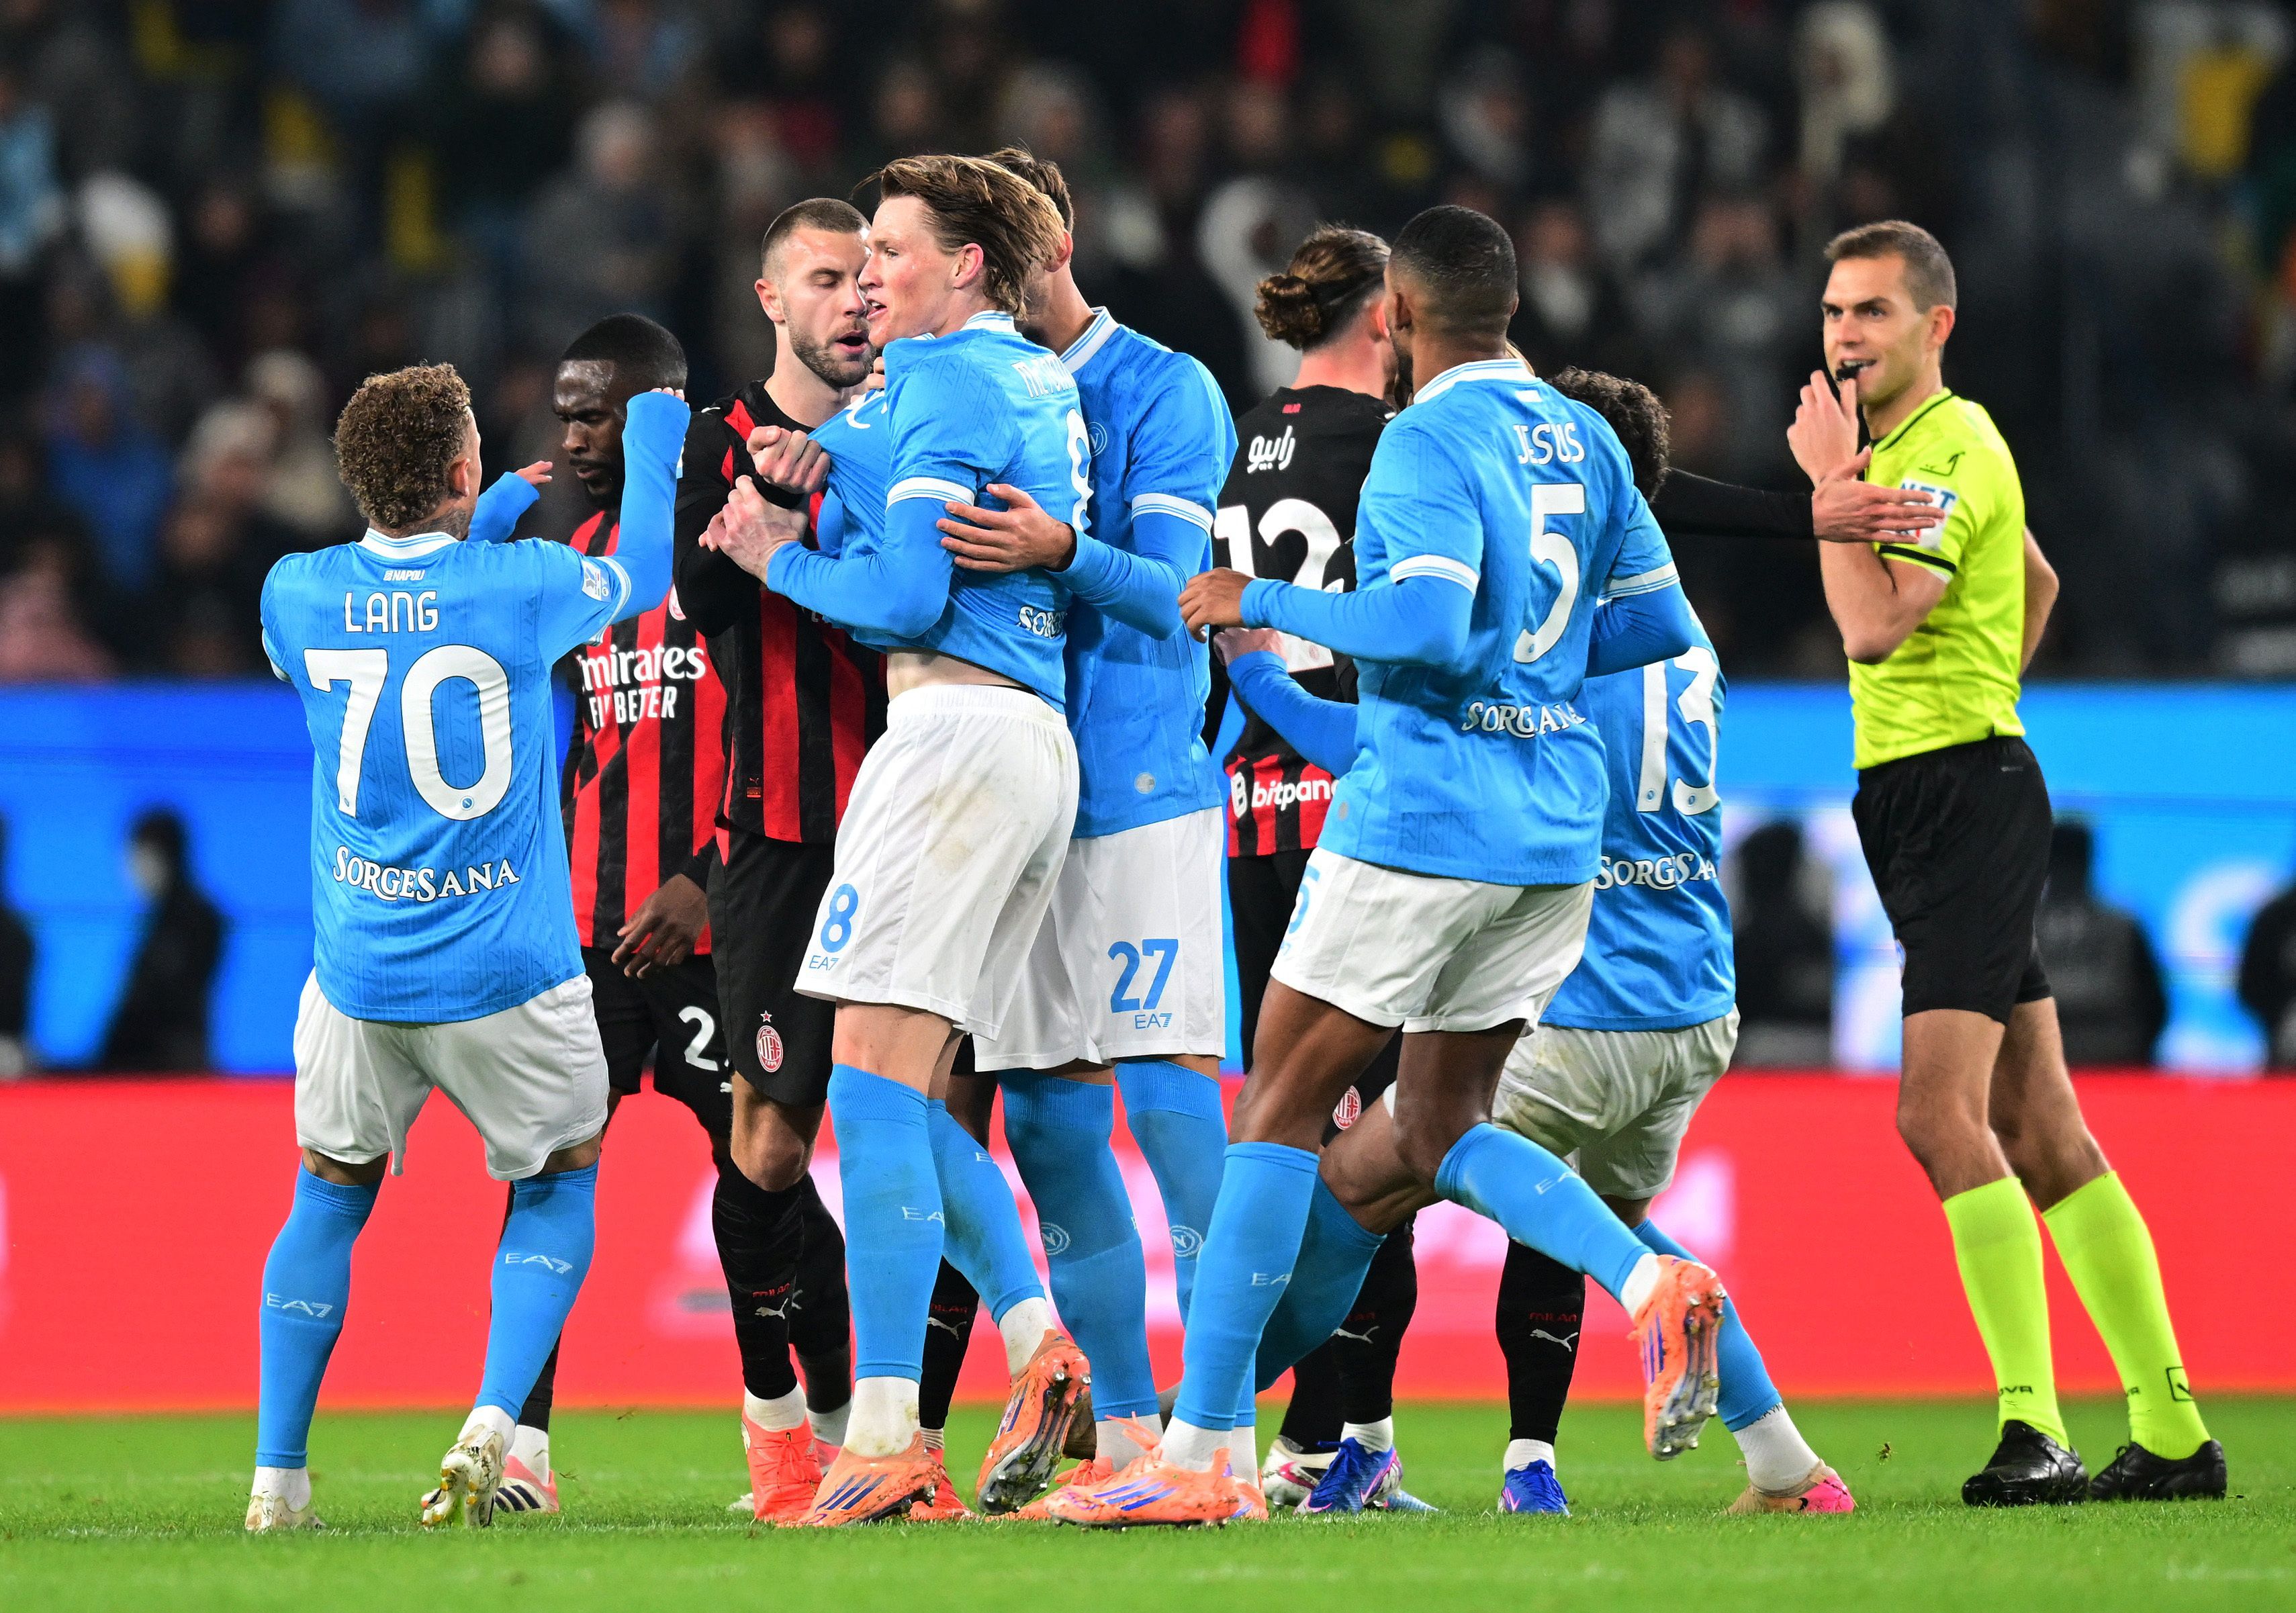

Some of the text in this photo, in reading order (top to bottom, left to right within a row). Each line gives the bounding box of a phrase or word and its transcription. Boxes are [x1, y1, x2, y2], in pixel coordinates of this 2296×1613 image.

[1247, 425, 1295, 473] رابيو
[1513, 483, 1586, 663] 5
[345, 591, 439, 633] LANG
[576, 641, 706, 692] mirates
[303, 643, 513, 821] 70
[1637, 645, 1720, 816] 13
[332, 845, 520, 903] SORGESANA
[820, 883, 858, 953] 8
[809, 955, 839, 971] EA7
[1107, 938, 1179, 1013] 27
[1134, 1012, 1172, 1029] EA7
[504, 1253, 573, 1275] EA7
[266, 1293, 333, 1318] EA7
